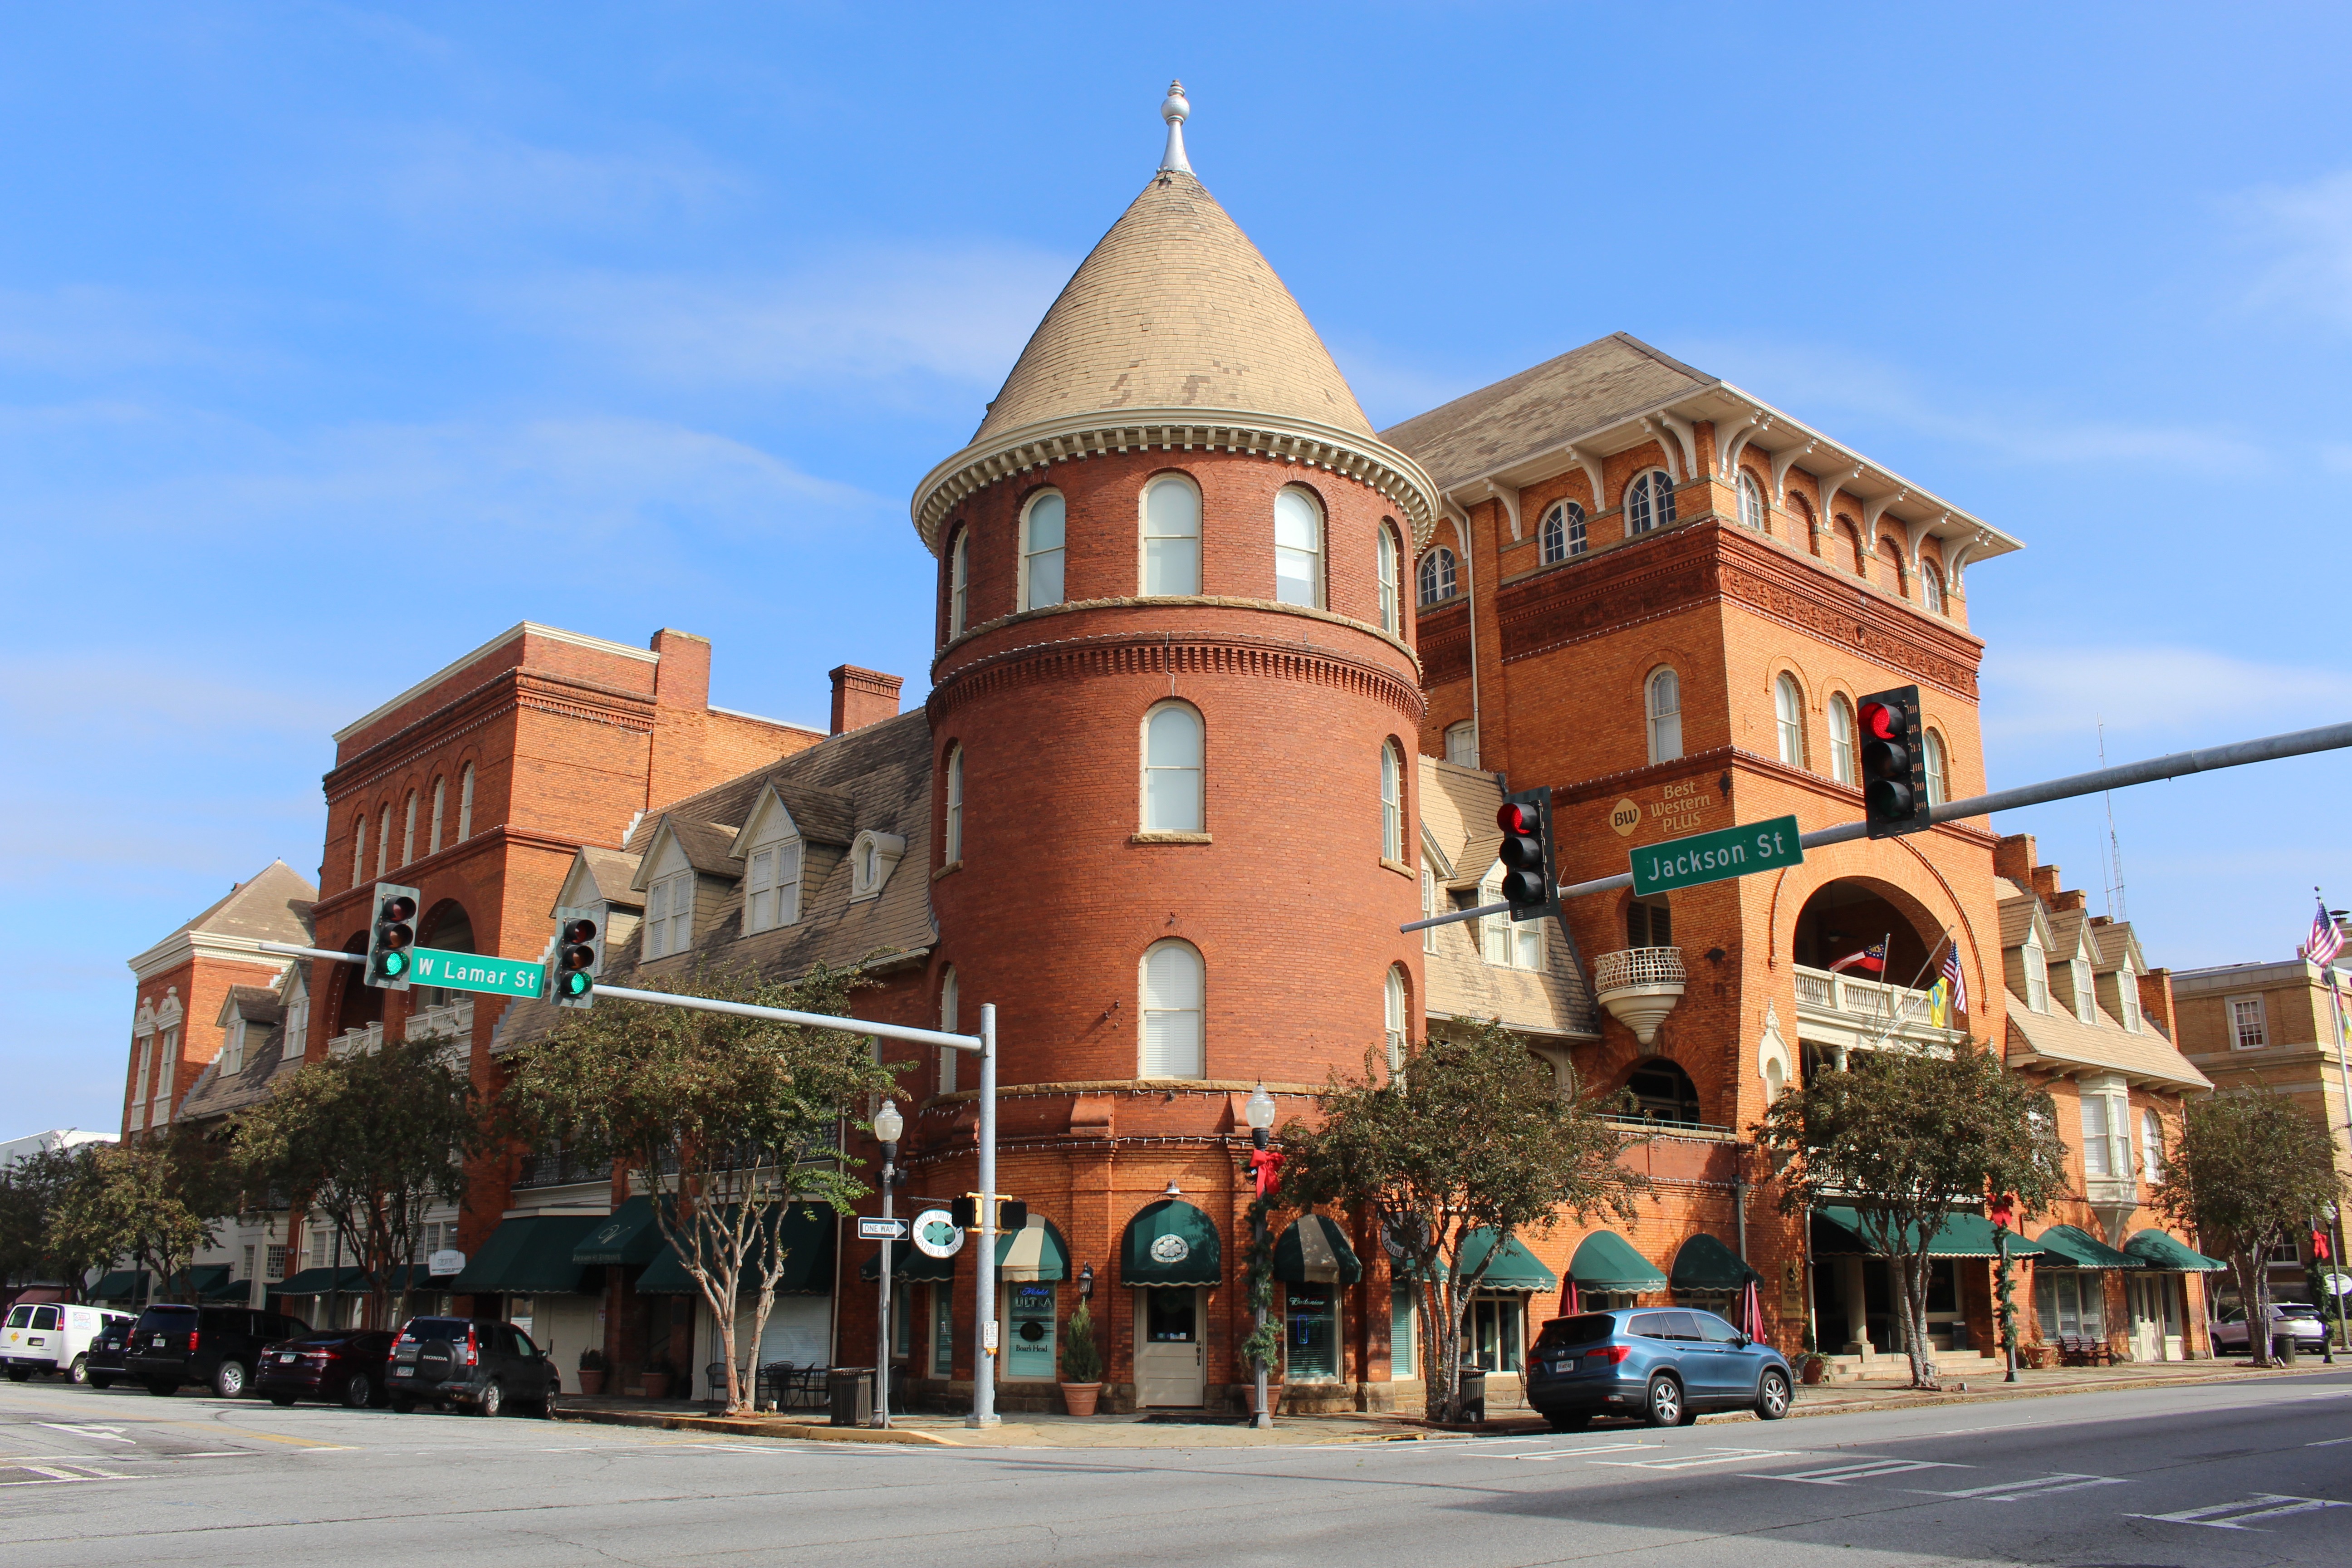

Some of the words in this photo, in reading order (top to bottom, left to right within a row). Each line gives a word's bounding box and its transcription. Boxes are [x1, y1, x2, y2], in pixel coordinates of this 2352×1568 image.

[1663, 780, 1696, 800] Best
[1650, 794, 1710, 818] Western
[1614, 808, 1637, 827] BW
[1662, 811, 1702, 833] PLUS
[1647, 843, 1746, 882] Jackson
[1757, 831, 1785, 858] St
[419, 957, 434, 976] W
[444, 961, 507, 985] Lamar
[514, 969, 536, 989] St
[864, 1224, 878, 1232] ONE
[880, 1225, 894, 1233] WAY
[915, 1213, 933, 1230] LITTLE
[916, 1235, 935, 1255] BISTRO
[944, 1241, 960, 1256] CAFE
[1289, 1297, 1324, 1306] Budweiser
